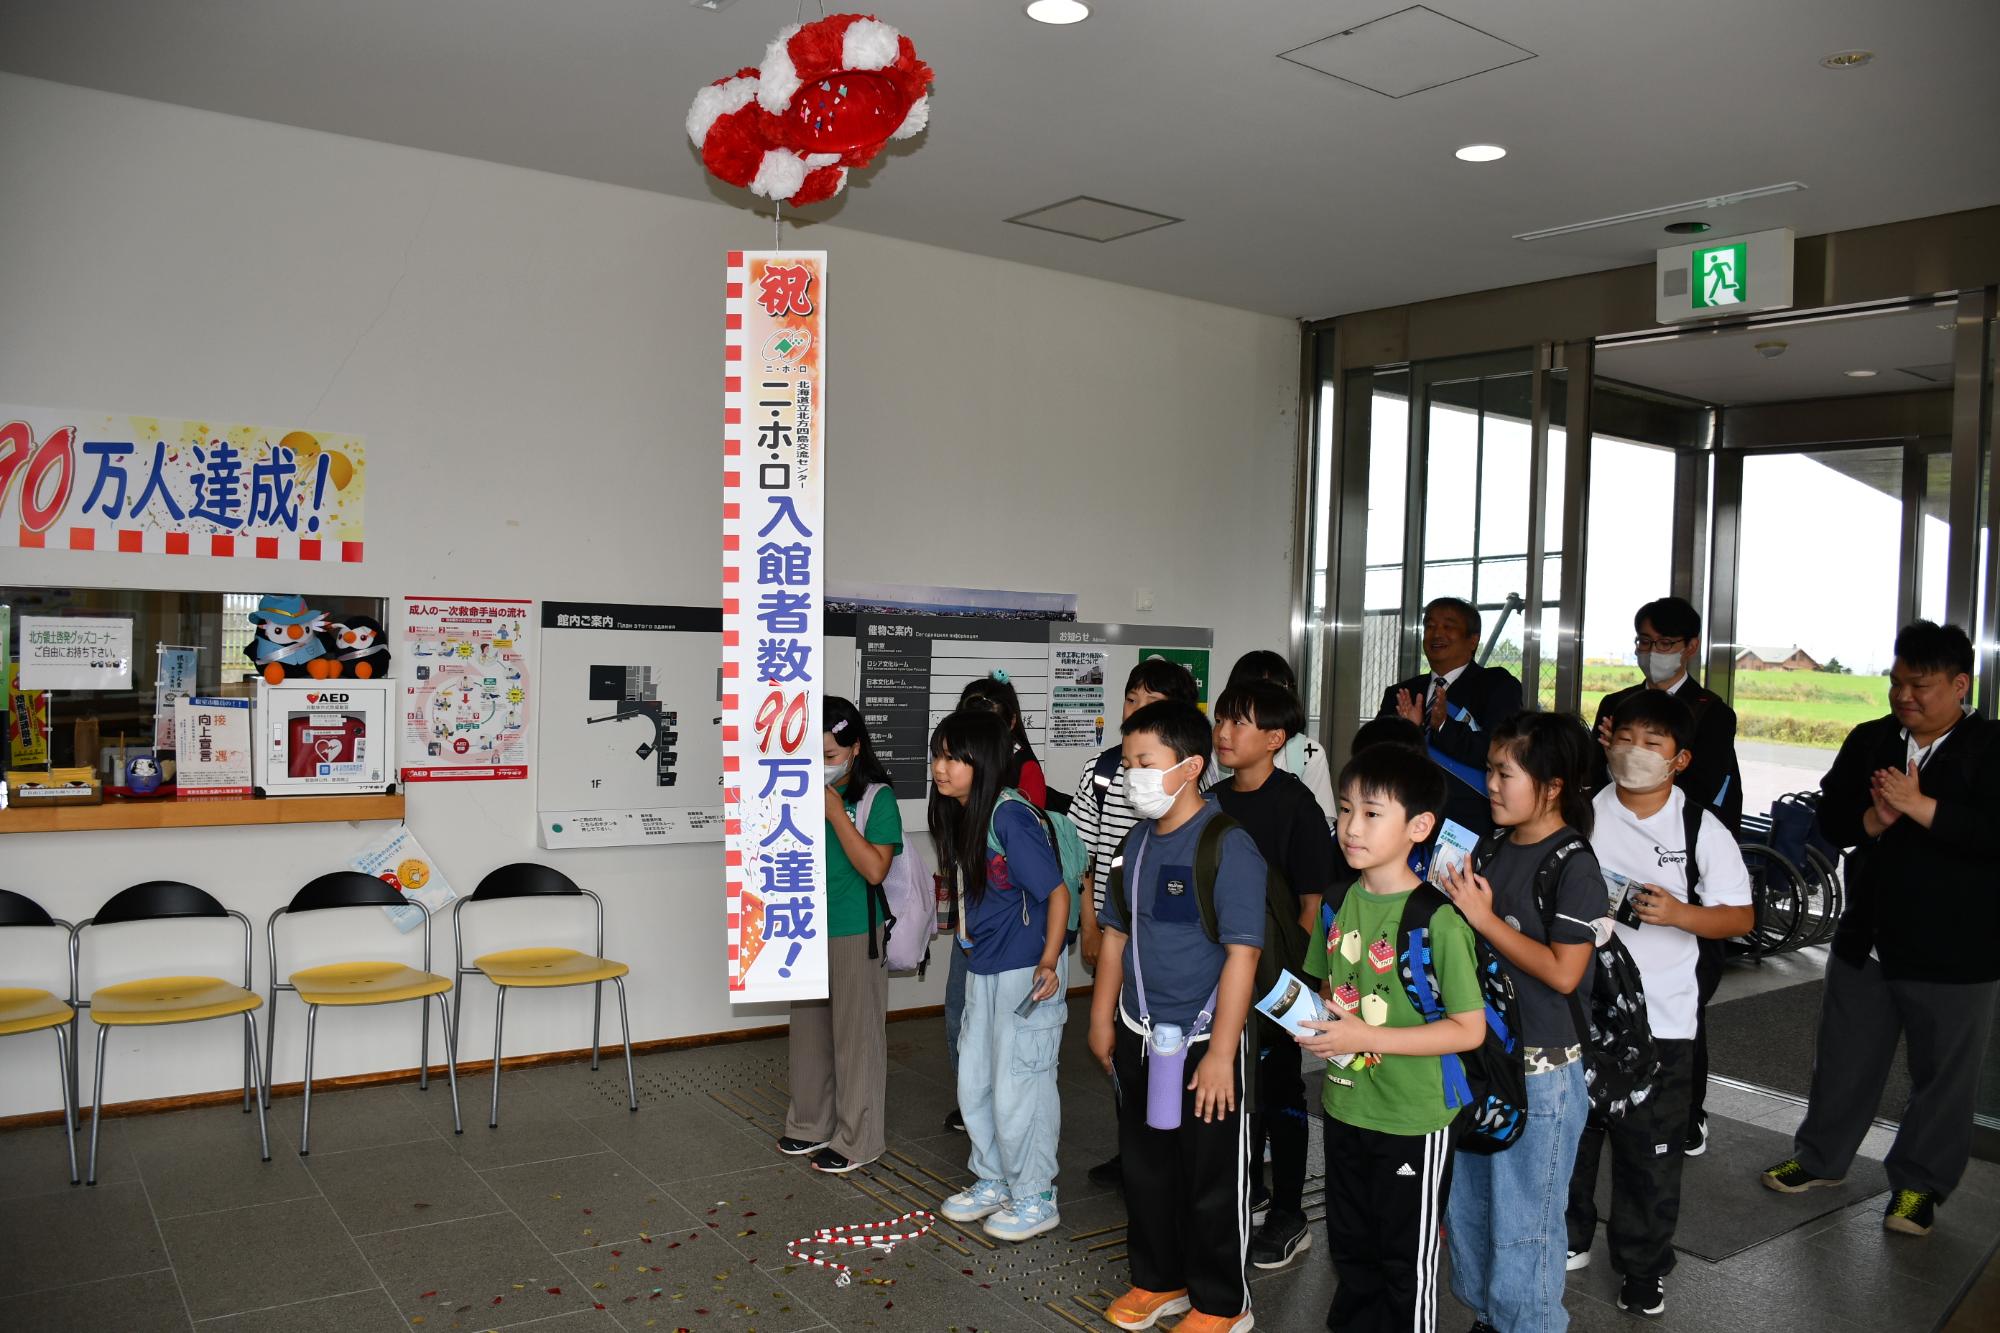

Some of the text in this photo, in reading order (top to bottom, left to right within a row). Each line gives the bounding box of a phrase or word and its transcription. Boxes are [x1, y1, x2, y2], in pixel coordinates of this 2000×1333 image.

[757, 265, 812, 317] 祝
[409, 605, 527, 618] 成人の一次救命手当の流れ
[557, 613, 614, 628] 館内ご案内
[868, 624, 913, 637] 催物ご案内
[1059, 631, 1090, 642] お知らせ
[29, 631, 118, 645] 北方領土啓発グッズコーナー
[34, 646, 117, 658] ご自由にお持ち下さい。
[866, 660, 909, 668] ロシア文化ルーム
[866, 678, 907, 686] 日本文化ルーム
[319, 693, 350, 703] AED
[198, 713, 212, 763] 向上宣言
[591, 779, 602, 789] 1F
